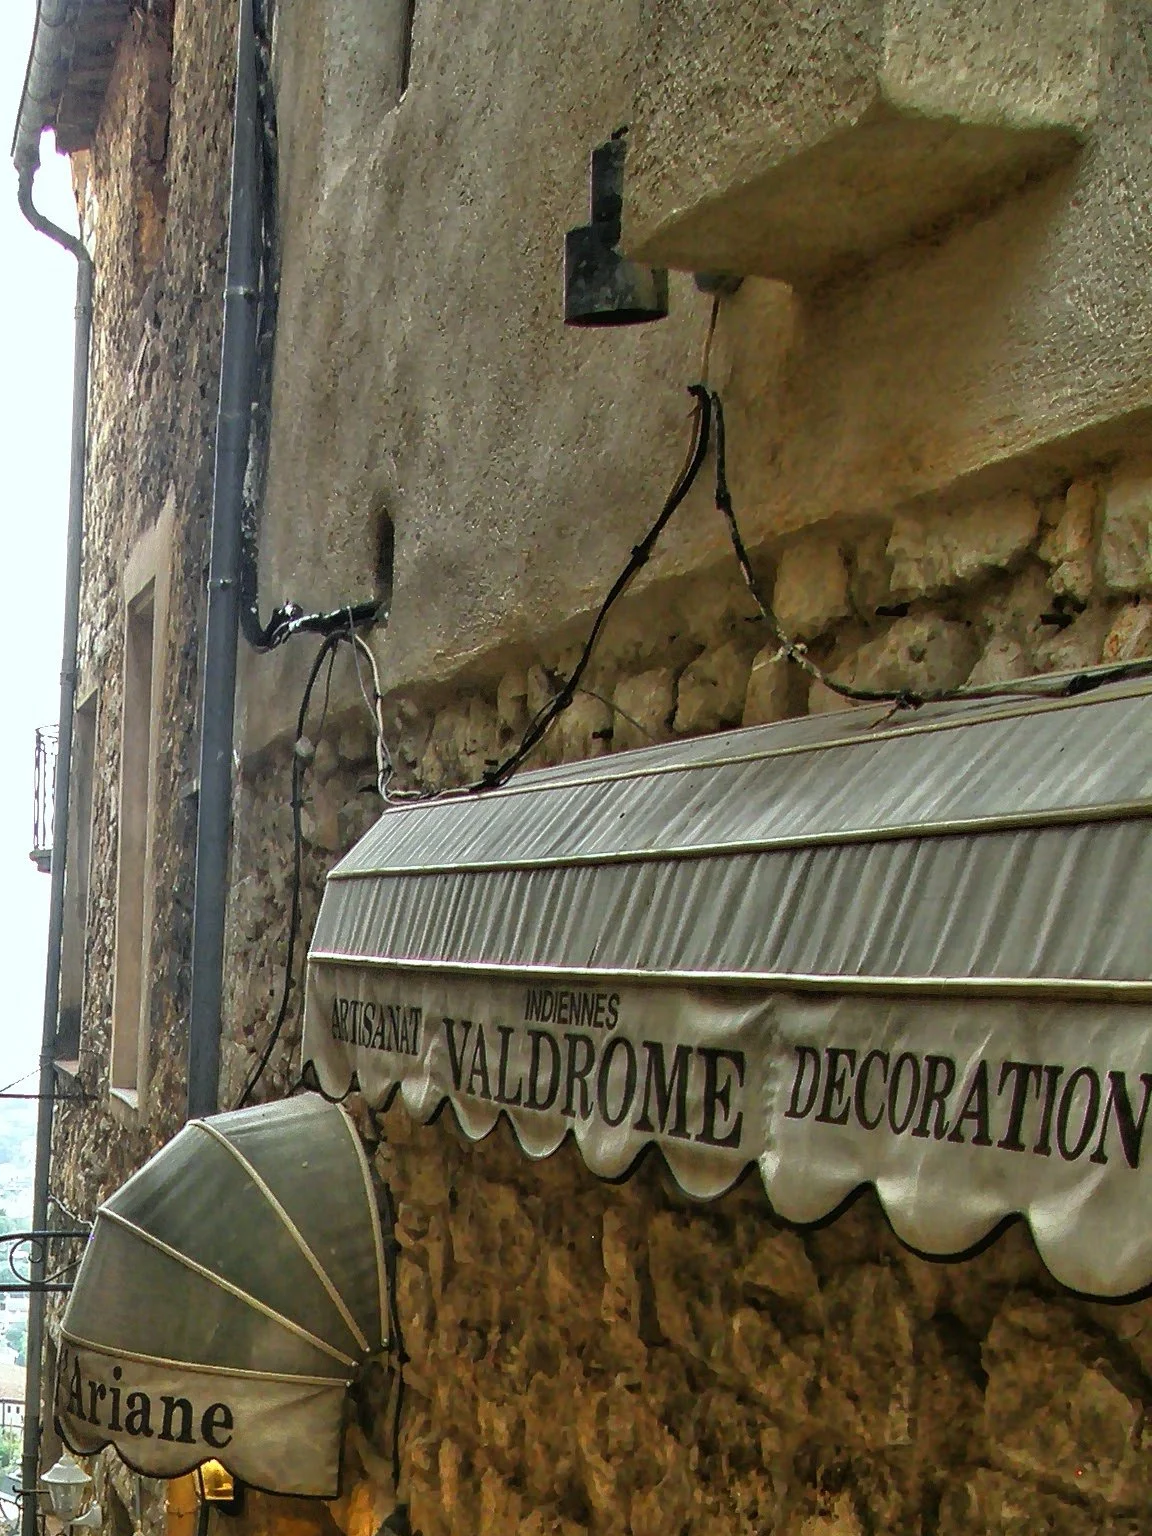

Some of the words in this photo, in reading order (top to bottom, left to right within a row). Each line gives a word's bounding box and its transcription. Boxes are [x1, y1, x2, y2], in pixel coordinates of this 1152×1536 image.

[524, 989, 621, 1030] INDIENNES
[331, 997, 423, 1057] ARTISANAT
[443, 1018, 746, 1149] VALDROME
[786, 1045, 1152, 1170] DECORATION
